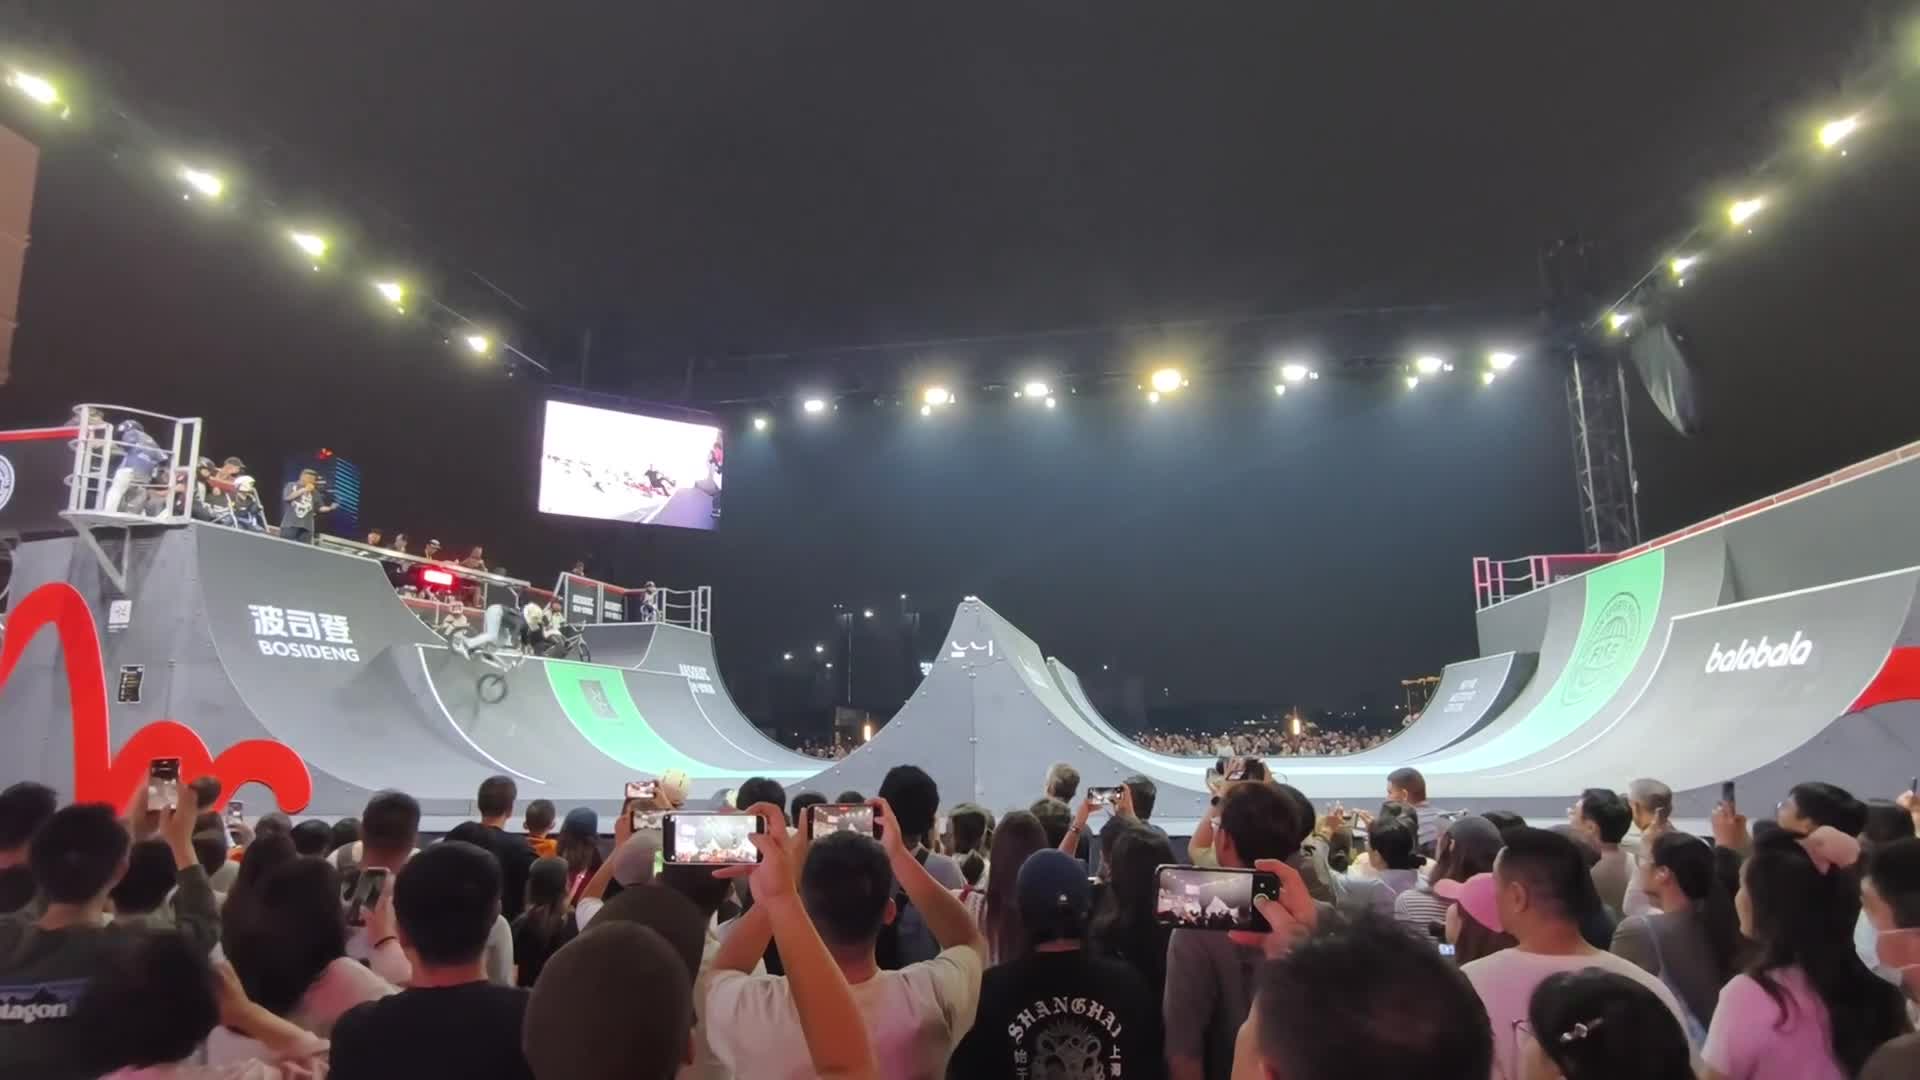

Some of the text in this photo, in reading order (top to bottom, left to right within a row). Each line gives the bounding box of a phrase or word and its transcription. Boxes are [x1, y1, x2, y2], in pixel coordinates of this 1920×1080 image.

[248, 604, 353, 644] 波司登
[258, 640, 360, 662] BOSIDENG
[1705, 630, 1812, 672] balabala
